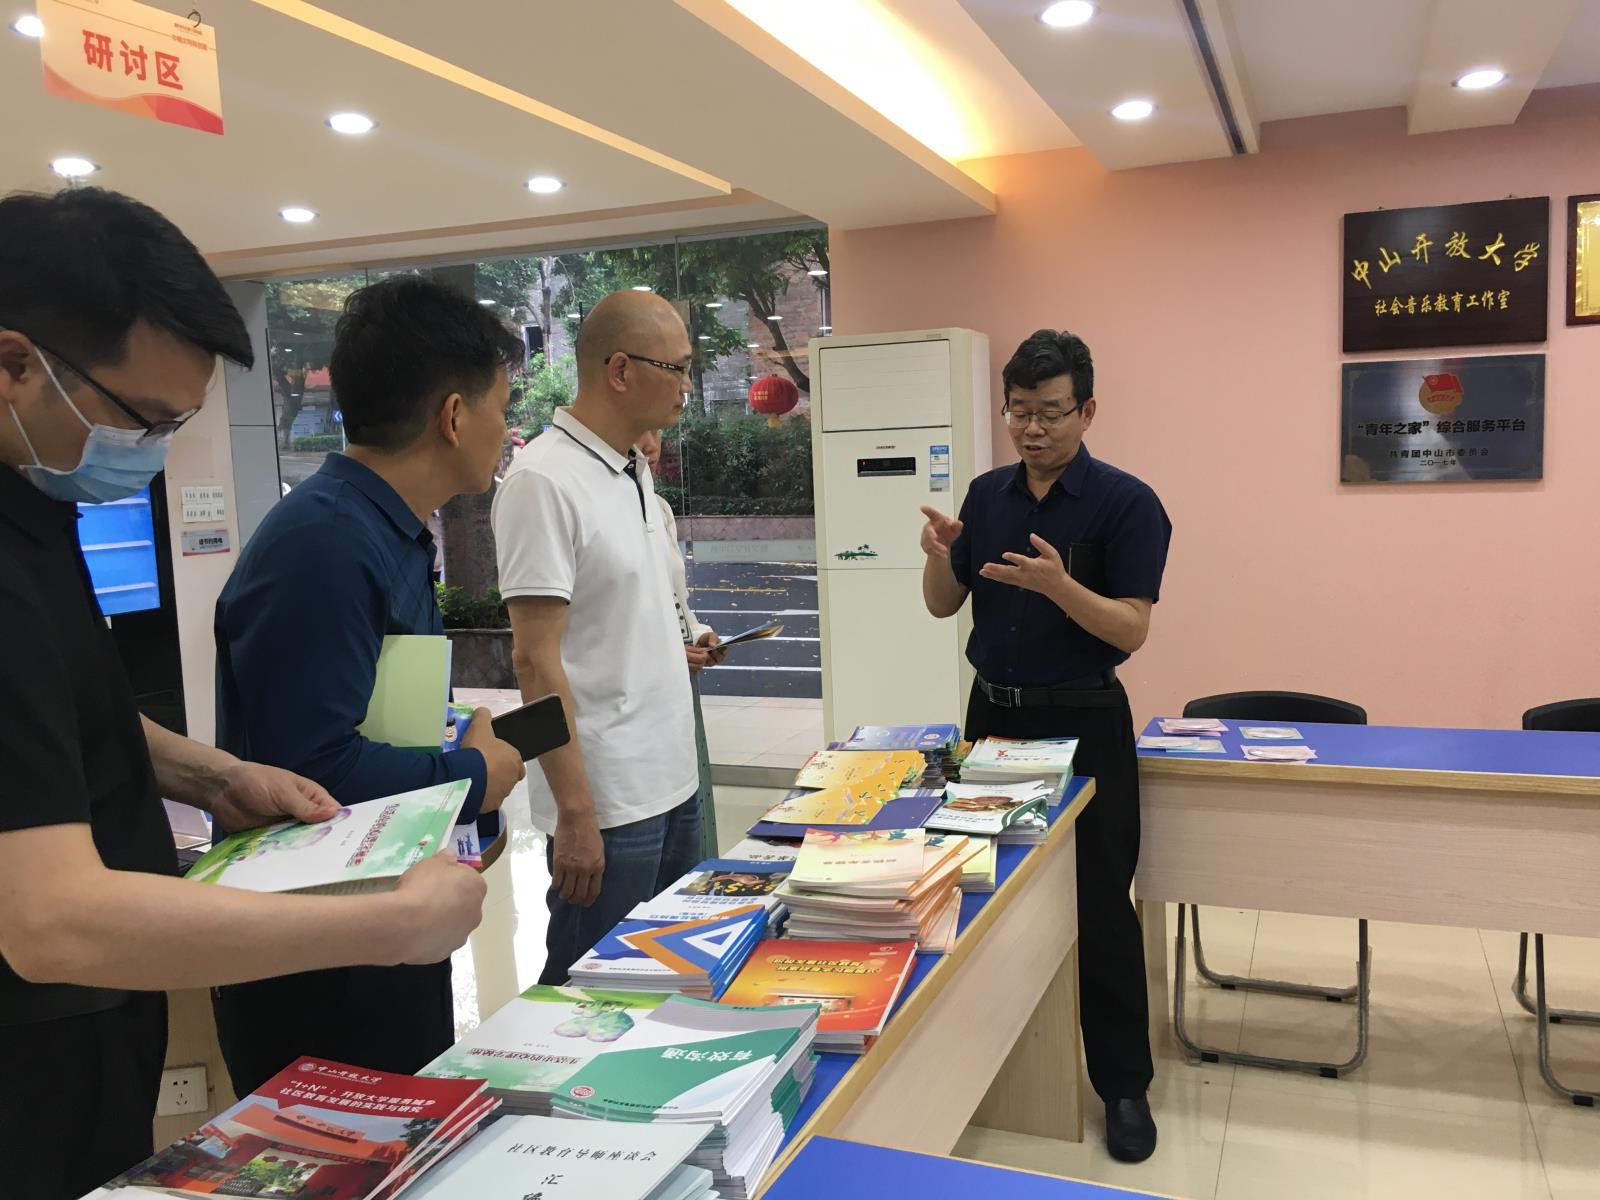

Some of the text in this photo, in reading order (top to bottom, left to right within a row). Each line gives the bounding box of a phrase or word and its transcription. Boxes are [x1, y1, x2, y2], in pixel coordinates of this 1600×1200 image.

[82, 29, 183, 90] 研讨区
[1351, 231, 1540, 289] 中山开放大学
[1374, 289, 1511, 317] 社会音乐教育工作室
[660, 1047, 753, 1062] 有效沟通
[507, 1143, 657, 1161] 社区教育导师座谈会
